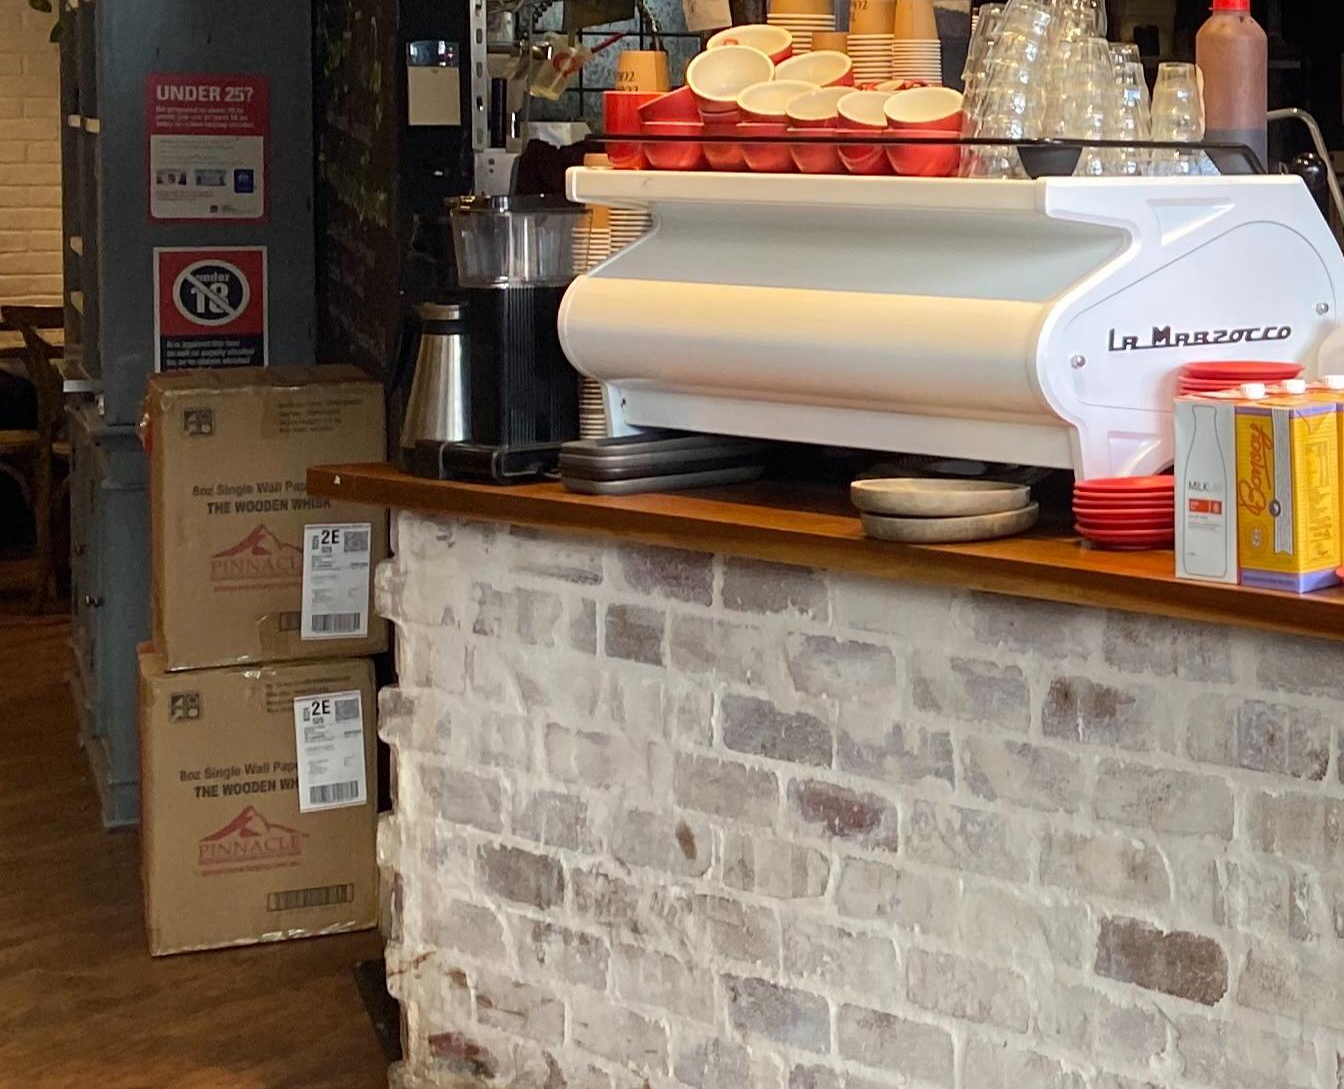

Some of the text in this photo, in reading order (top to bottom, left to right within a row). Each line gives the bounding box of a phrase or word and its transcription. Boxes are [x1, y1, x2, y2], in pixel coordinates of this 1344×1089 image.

[156, 85, 254, 102] UNDER 25?
[190, 282, 229, 313] 18
[1239, 423, 1274, 517] Bonsoy
[217, 483, 253, 497] Single
[256, 482, 283, 493] Wall
[285, 481, 308, 493] Pap
[207, 498, 332, 515] THE WOODEN WHISK
[321, 529, 340, 544] 2E
[211, 558, 303, 577] PINNACL
[311, 699, 331, 716] 2E
[204, 766, 240, 780] Single
[244, 763, 270, 775] Wall
[273, 761, 298, 774] Pap
[194, 784, 219, 798] THE
[222, 780, 276, 796] WOODEN
